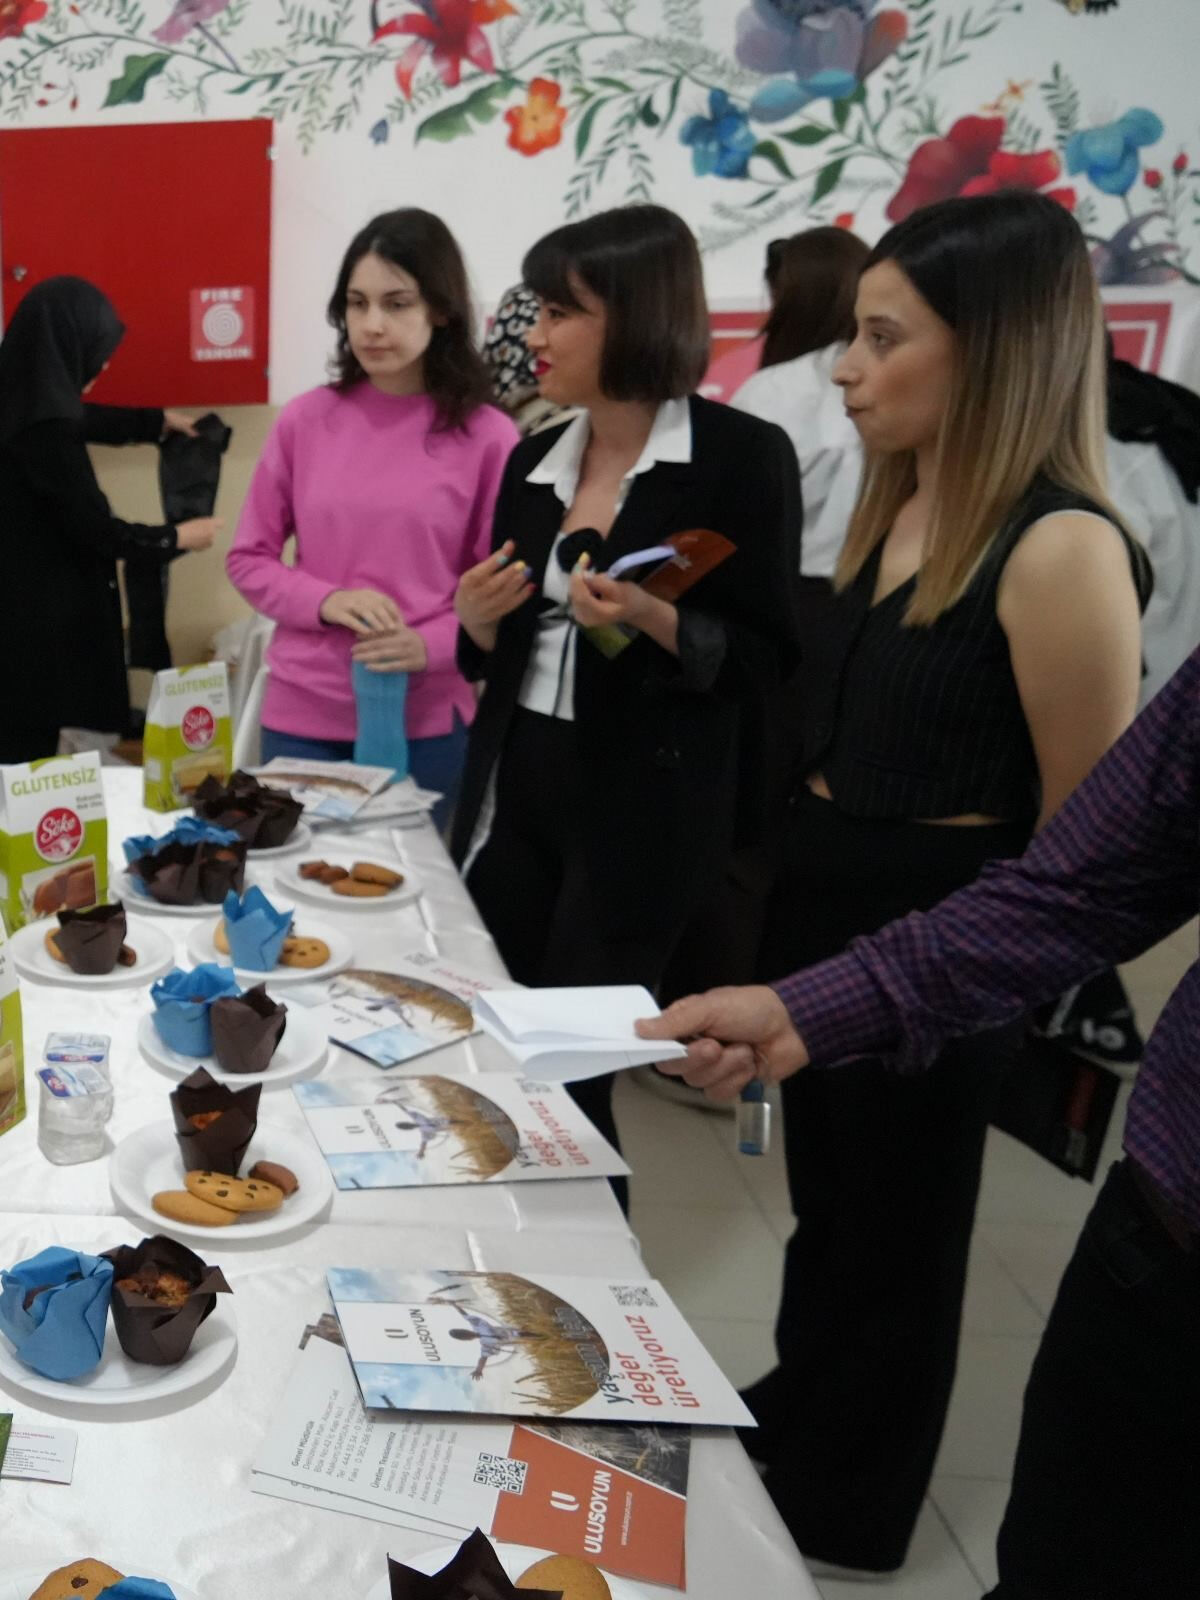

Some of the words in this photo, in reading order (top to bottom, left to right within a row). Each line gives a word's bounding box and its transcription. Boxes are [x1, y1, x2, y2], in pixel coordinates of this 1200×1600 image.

[11, 767, 97, 796] GLUTENSİZ
[40, 813, 76, 844] Söke
[408, 1308, 441, 1362] ULUSOYUN
[625, 1314, 701, 1408] üretiyoruz
[614, 1352, 663, 1406] değer
[584, 1469, 612, 1553] ULUSOYUN
